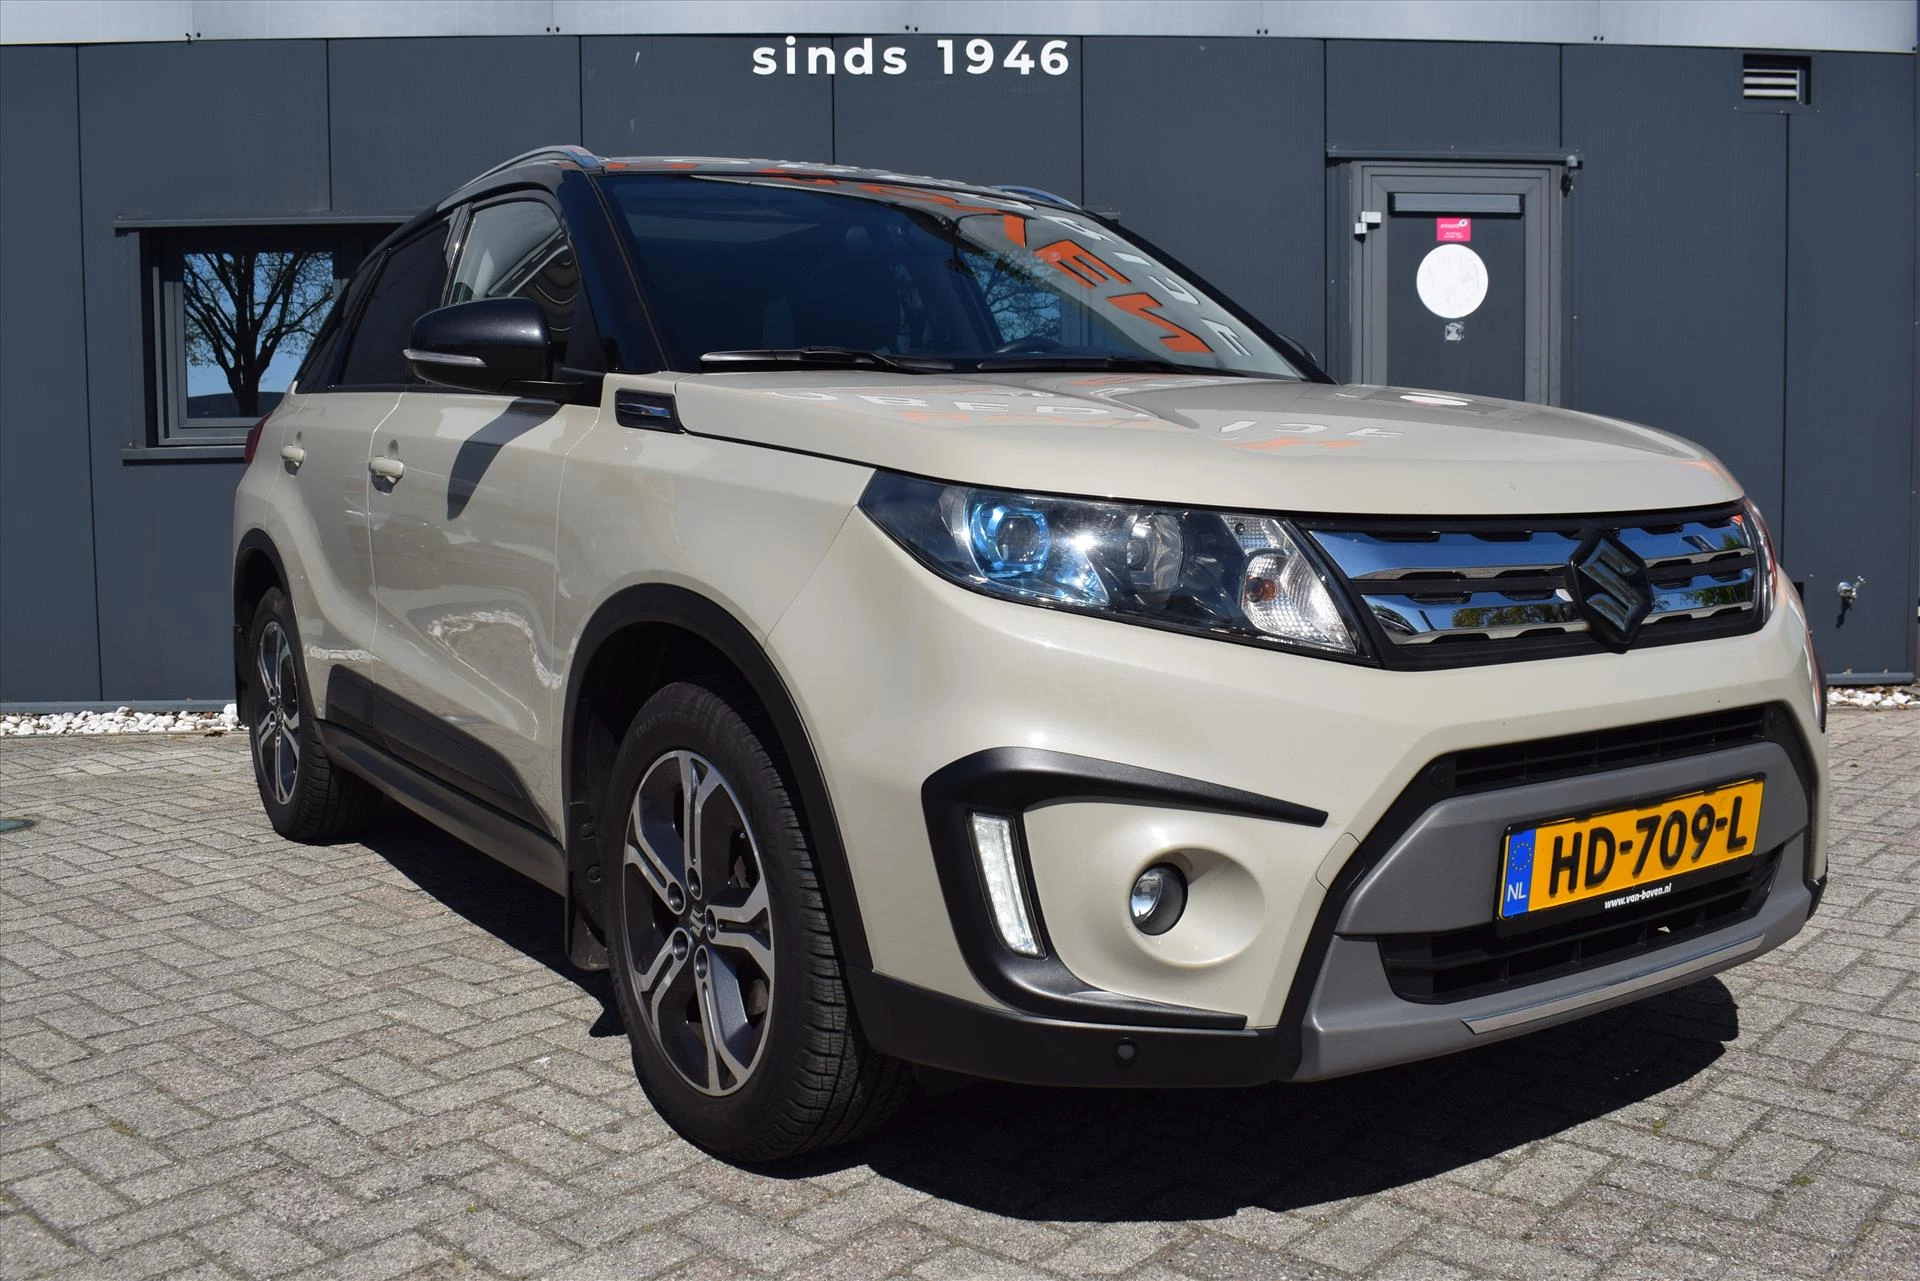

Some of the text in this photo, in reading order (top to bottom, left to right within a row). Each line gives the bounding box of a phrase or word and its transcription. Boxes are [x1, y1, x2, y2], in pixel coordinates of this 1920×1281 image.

[752, 36, 1069, 76] sinds 1946
[1549, 796, 1748, 896] HD-709-L
[1506, 881, 1527, 902] NL
[1604, 882, 1673, 909] www.van-boven.nl
